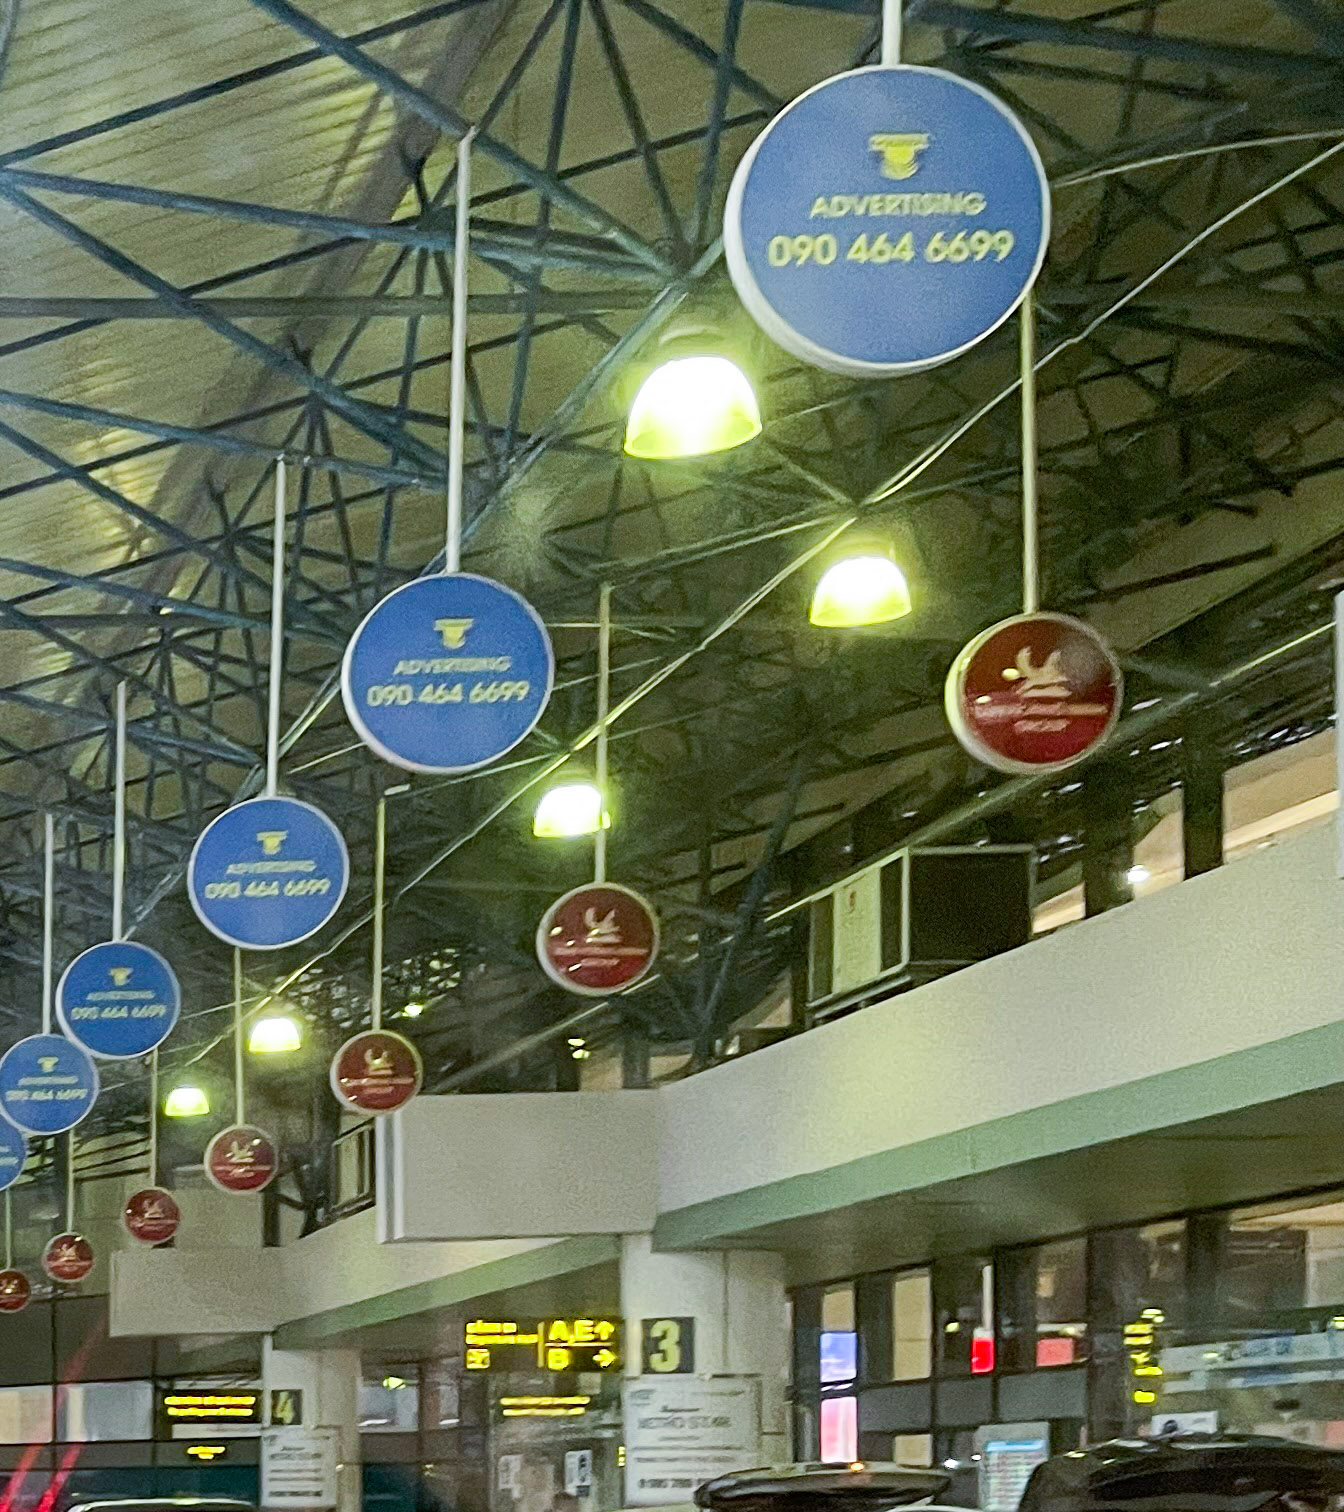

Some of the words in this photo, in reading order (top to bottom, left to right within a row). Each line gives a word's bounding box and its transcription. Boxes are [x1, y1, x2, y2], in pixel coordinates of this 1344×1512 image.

[810, 192, 987, 219] ADVERTISING
[769, 234, 836, 268] 090
[847, 231, 913, 265] 464
[925, 229, 1014, 263] 6699
[367, 684, 411, 707] 090
[418, 682, 462, 705] 464
[469, 680, 530, 703] 6699
[650, 1319, 680, 1373] 3
[273, 1391, 295, 1424] 4
